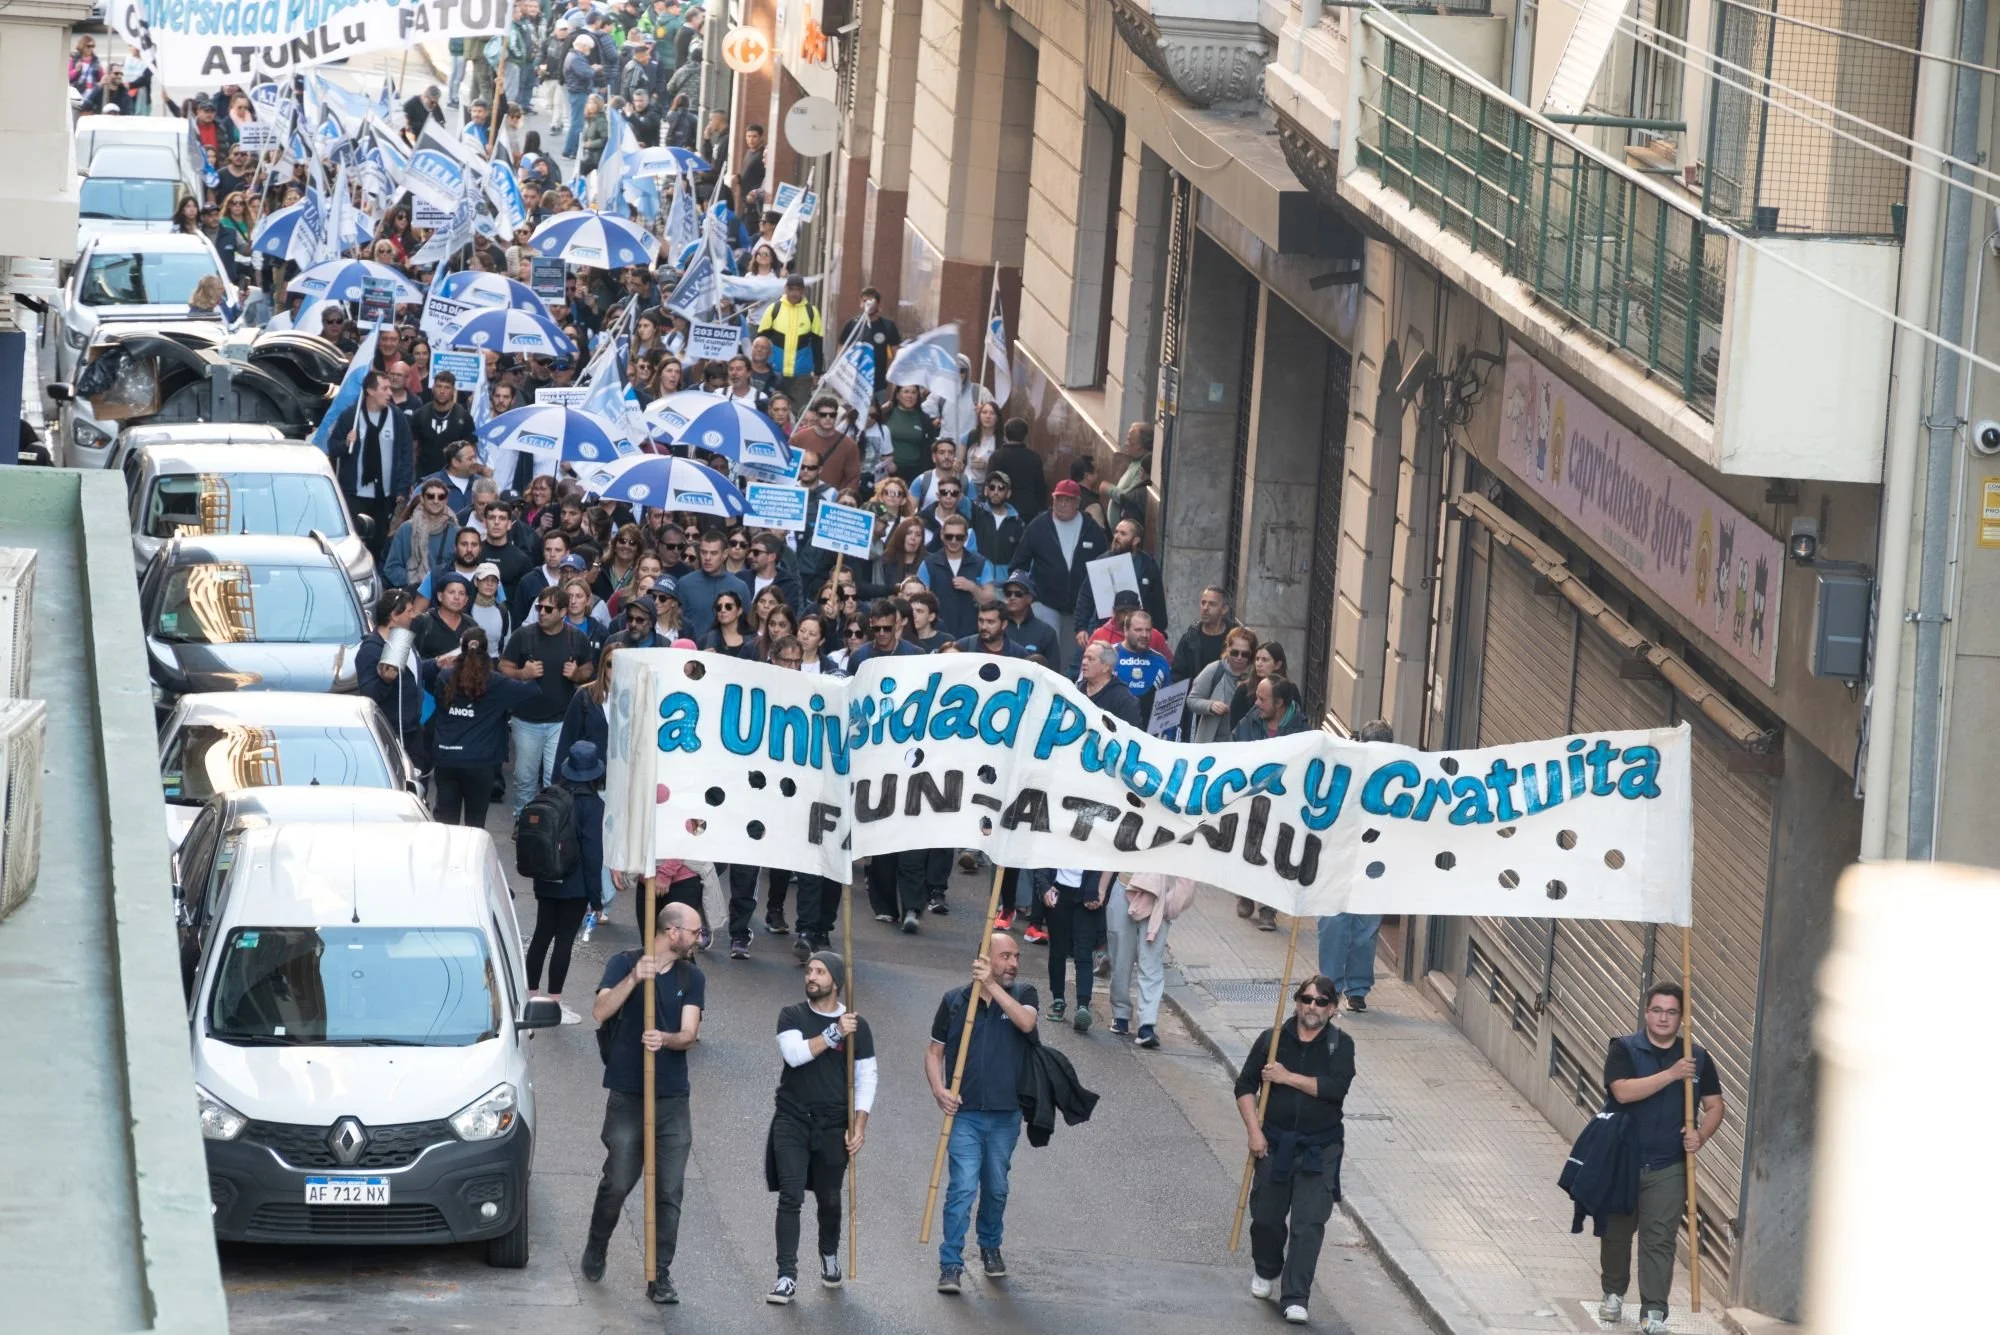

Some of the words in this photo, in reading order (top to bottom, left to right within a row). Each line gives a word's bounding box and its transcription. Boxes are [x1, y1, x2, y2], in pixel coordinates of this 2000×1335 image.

[430, 301, 448, 313] 203
[694, 327, 713, 337] 203
[714, 328, 736, 339] DÍAS
[1567, 431, 1651, 541] caprichosas
[1652, 476, 1693, 577] store
[1119, 656, 1151, 666] adidas
[657, 691, 702, 753] a
[1301, 758, 1352, 831] y
[1361, 738, 1661, 826] Gratuita
[309, 1186, 327, 1201] AF
[334, 1186, 361, 1202] 712
[367, 1187, 385, 1202] NX
